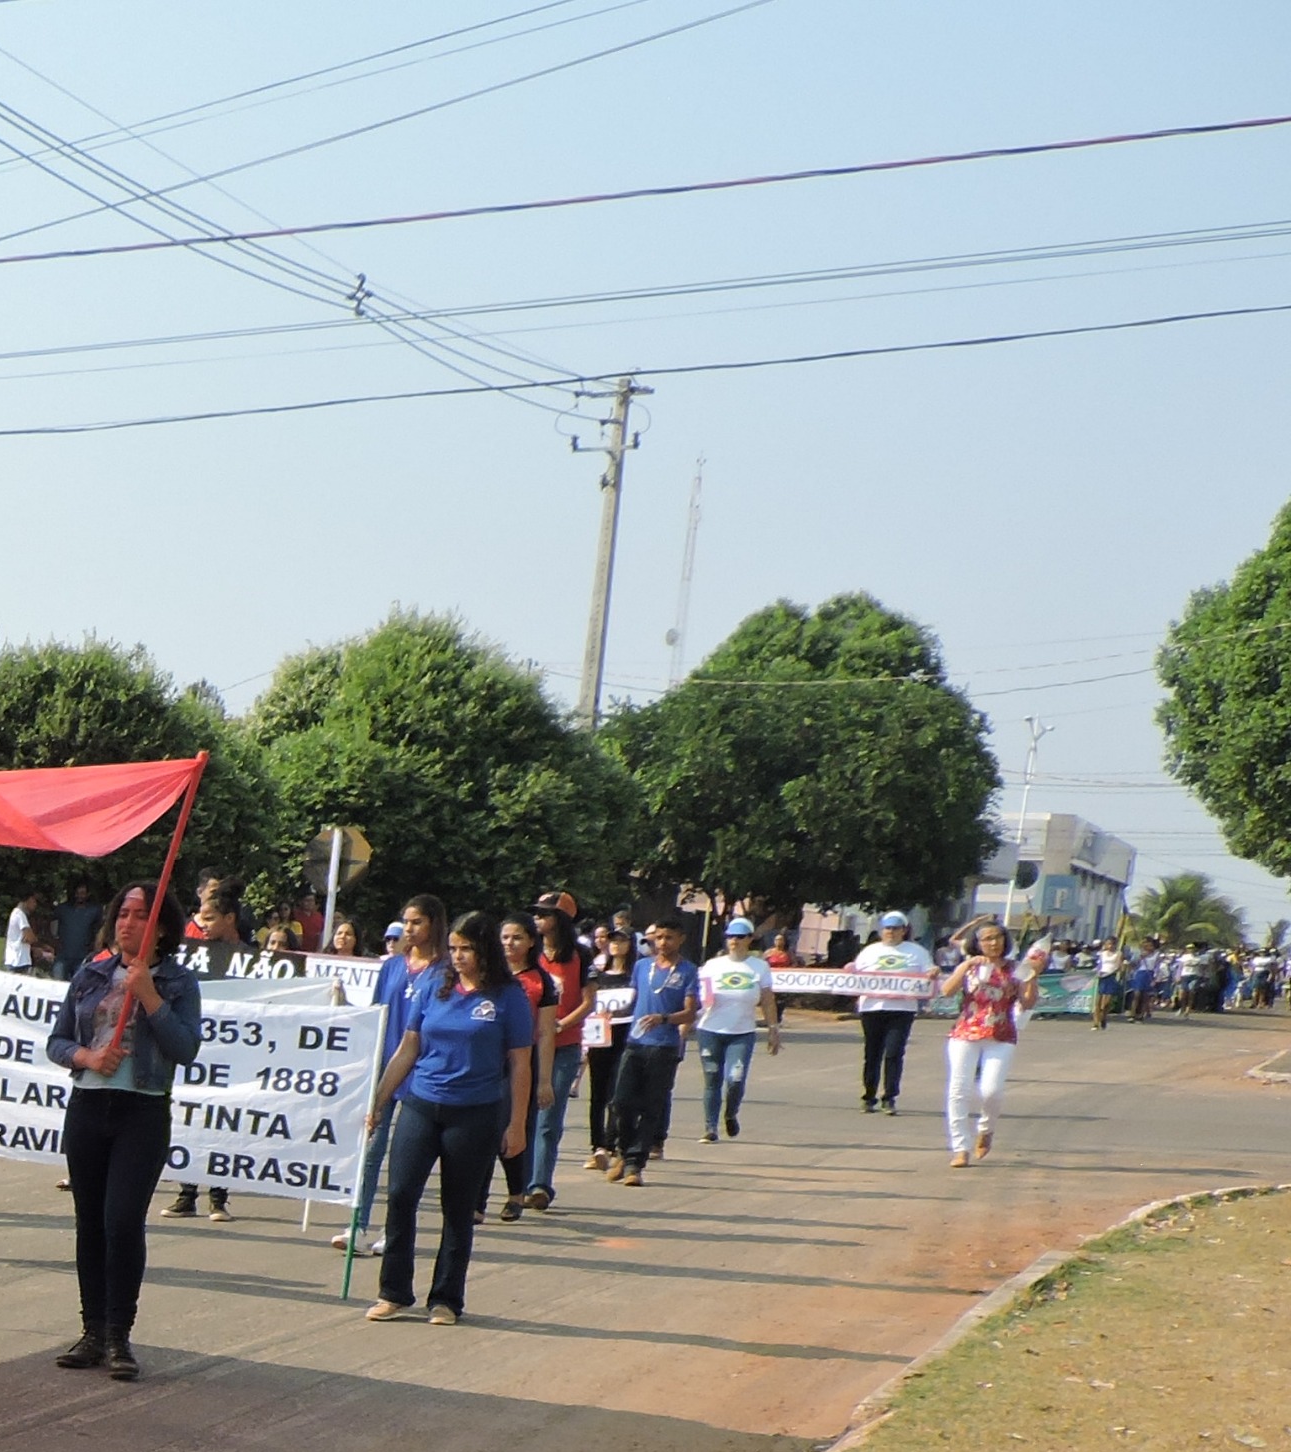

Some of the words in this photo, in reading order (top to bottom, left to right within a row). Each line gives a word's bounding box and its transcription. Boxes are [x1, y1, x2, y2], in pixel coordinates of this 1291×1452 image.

[298, 1025, 351, 1052] DE
[183, 1062, 231, 1089] DE
[256, 1067, 341, 1097] 1888
[172, 1100, 292, 1140] TINTA
[310, 1118, 337, 1145] A
[207, 1152, 352, 1195] BRASIL.
